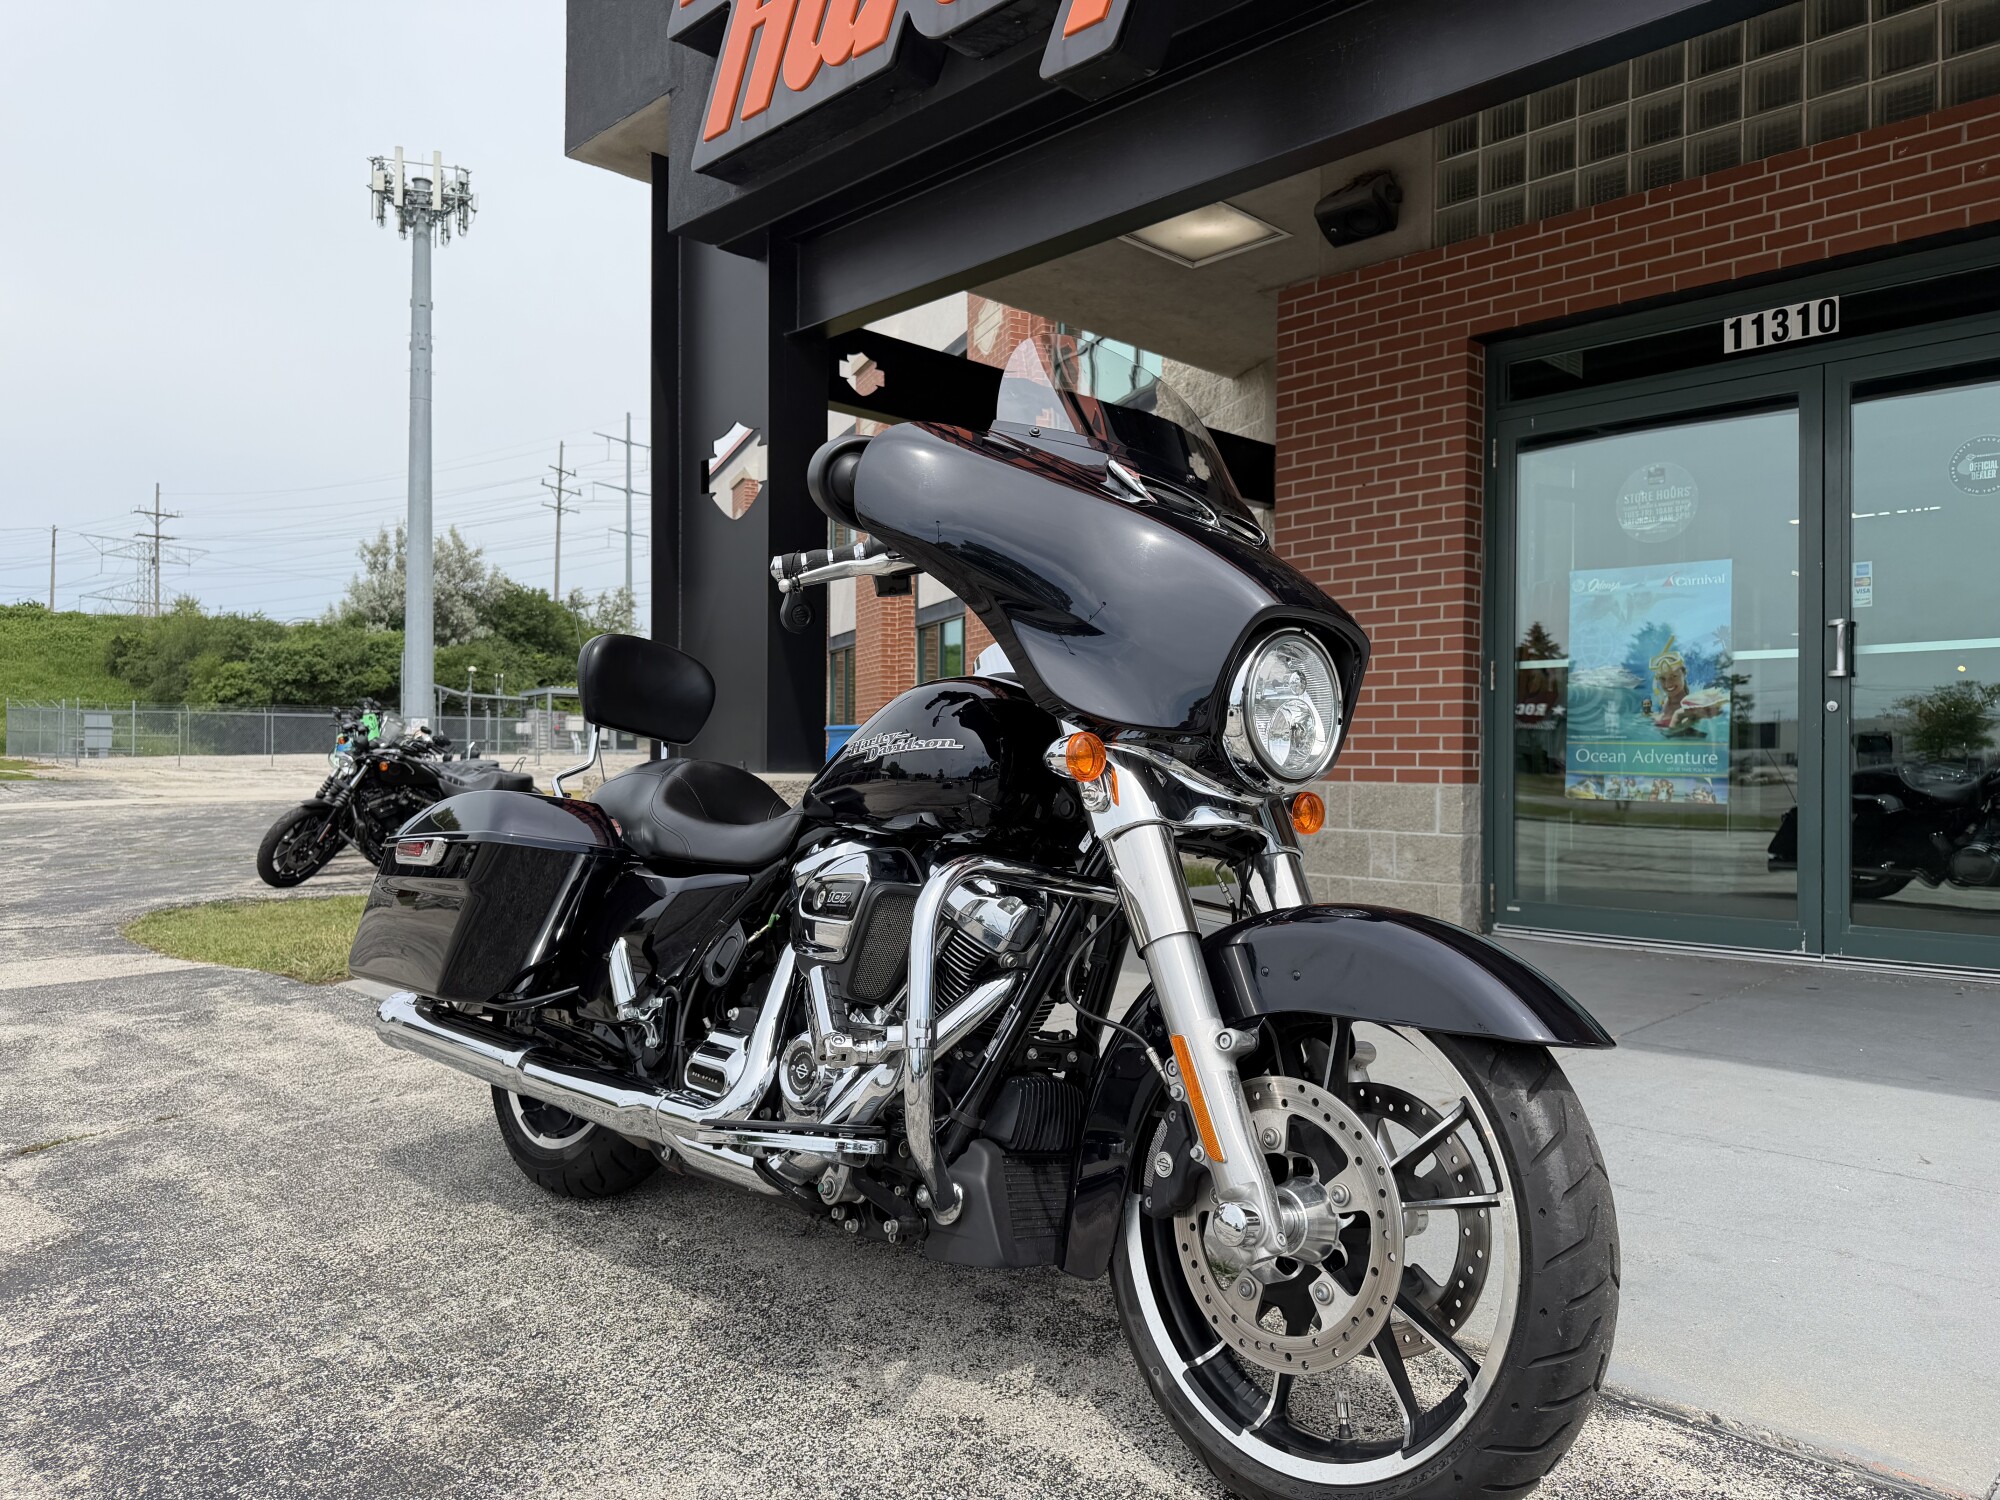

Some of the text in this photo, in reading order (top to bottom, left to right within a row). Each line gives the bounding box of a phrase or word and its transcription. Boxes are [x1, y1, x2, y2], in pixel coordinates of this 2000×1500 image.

[1729, 298, 1837, 350] 11310
[1969, 460, 1999, 472] OFFICIAL
[1971, 470, 1997, 480] DEALER
[1624, 485, 1692, 504] STORE HOURS
[1675, 573, 1725, 587] Carnival
[864, 736, 965, 763] Davidson
[1576, 748, 1718, 765] Ocean Adventure
[827, 891, 852, 904] 107
